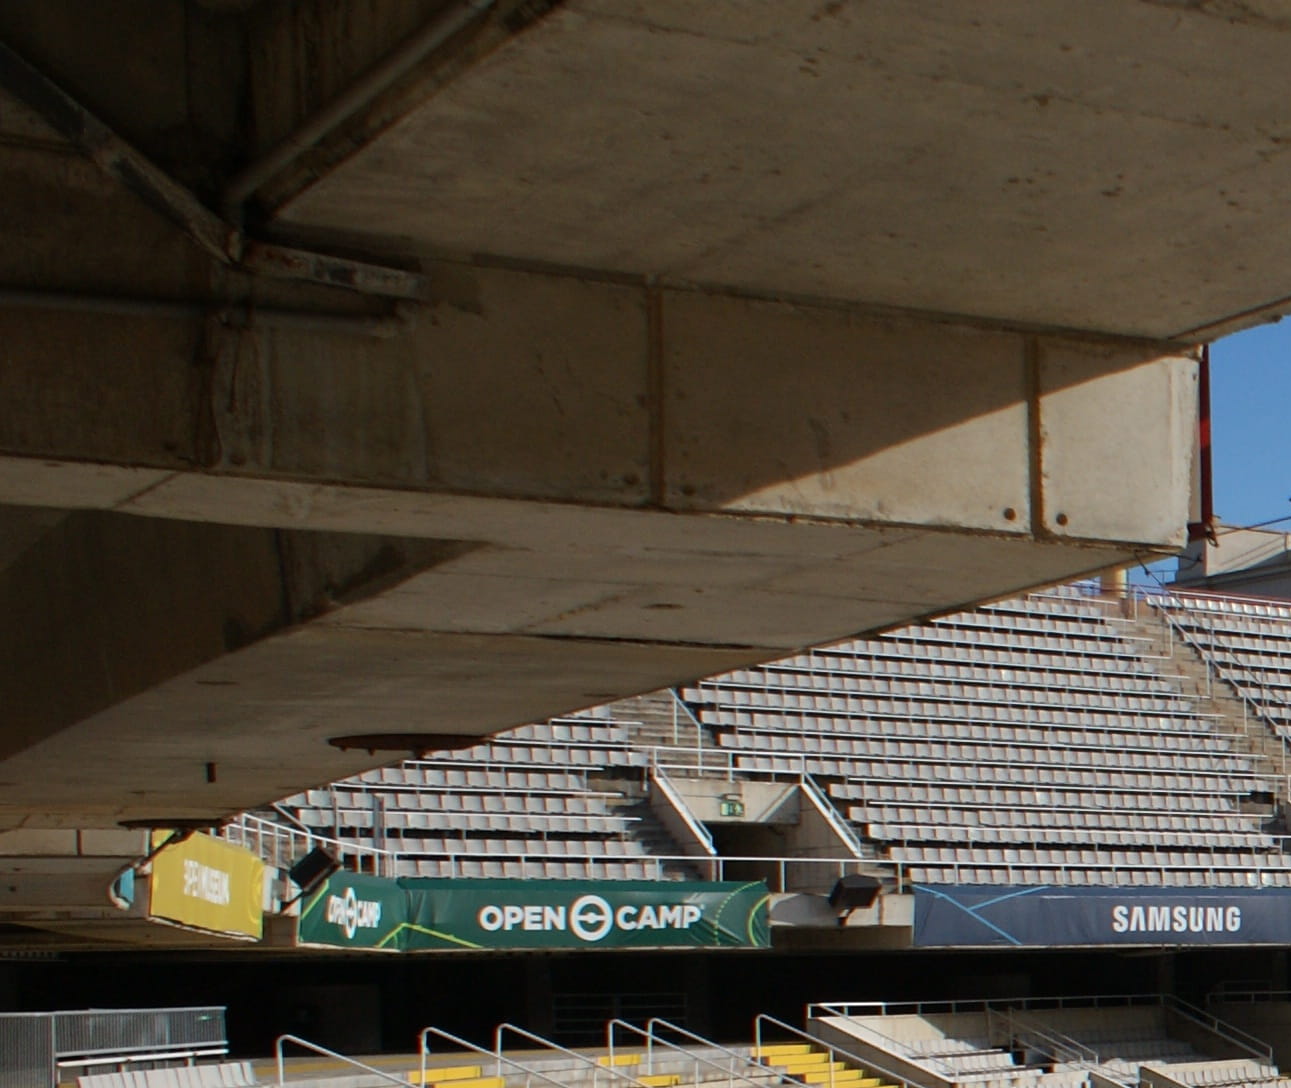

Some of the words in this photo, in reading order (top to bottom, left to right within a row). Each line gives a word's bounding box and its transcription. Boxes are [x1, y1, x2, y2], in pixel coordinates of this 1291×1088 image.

[357, 900, 381, 928] CAMP
[478, 905, 567, 931] OPEN
[615, 905, 702, 930] CAMP
[1112, 905, 1241, 933] SAMSUNG
